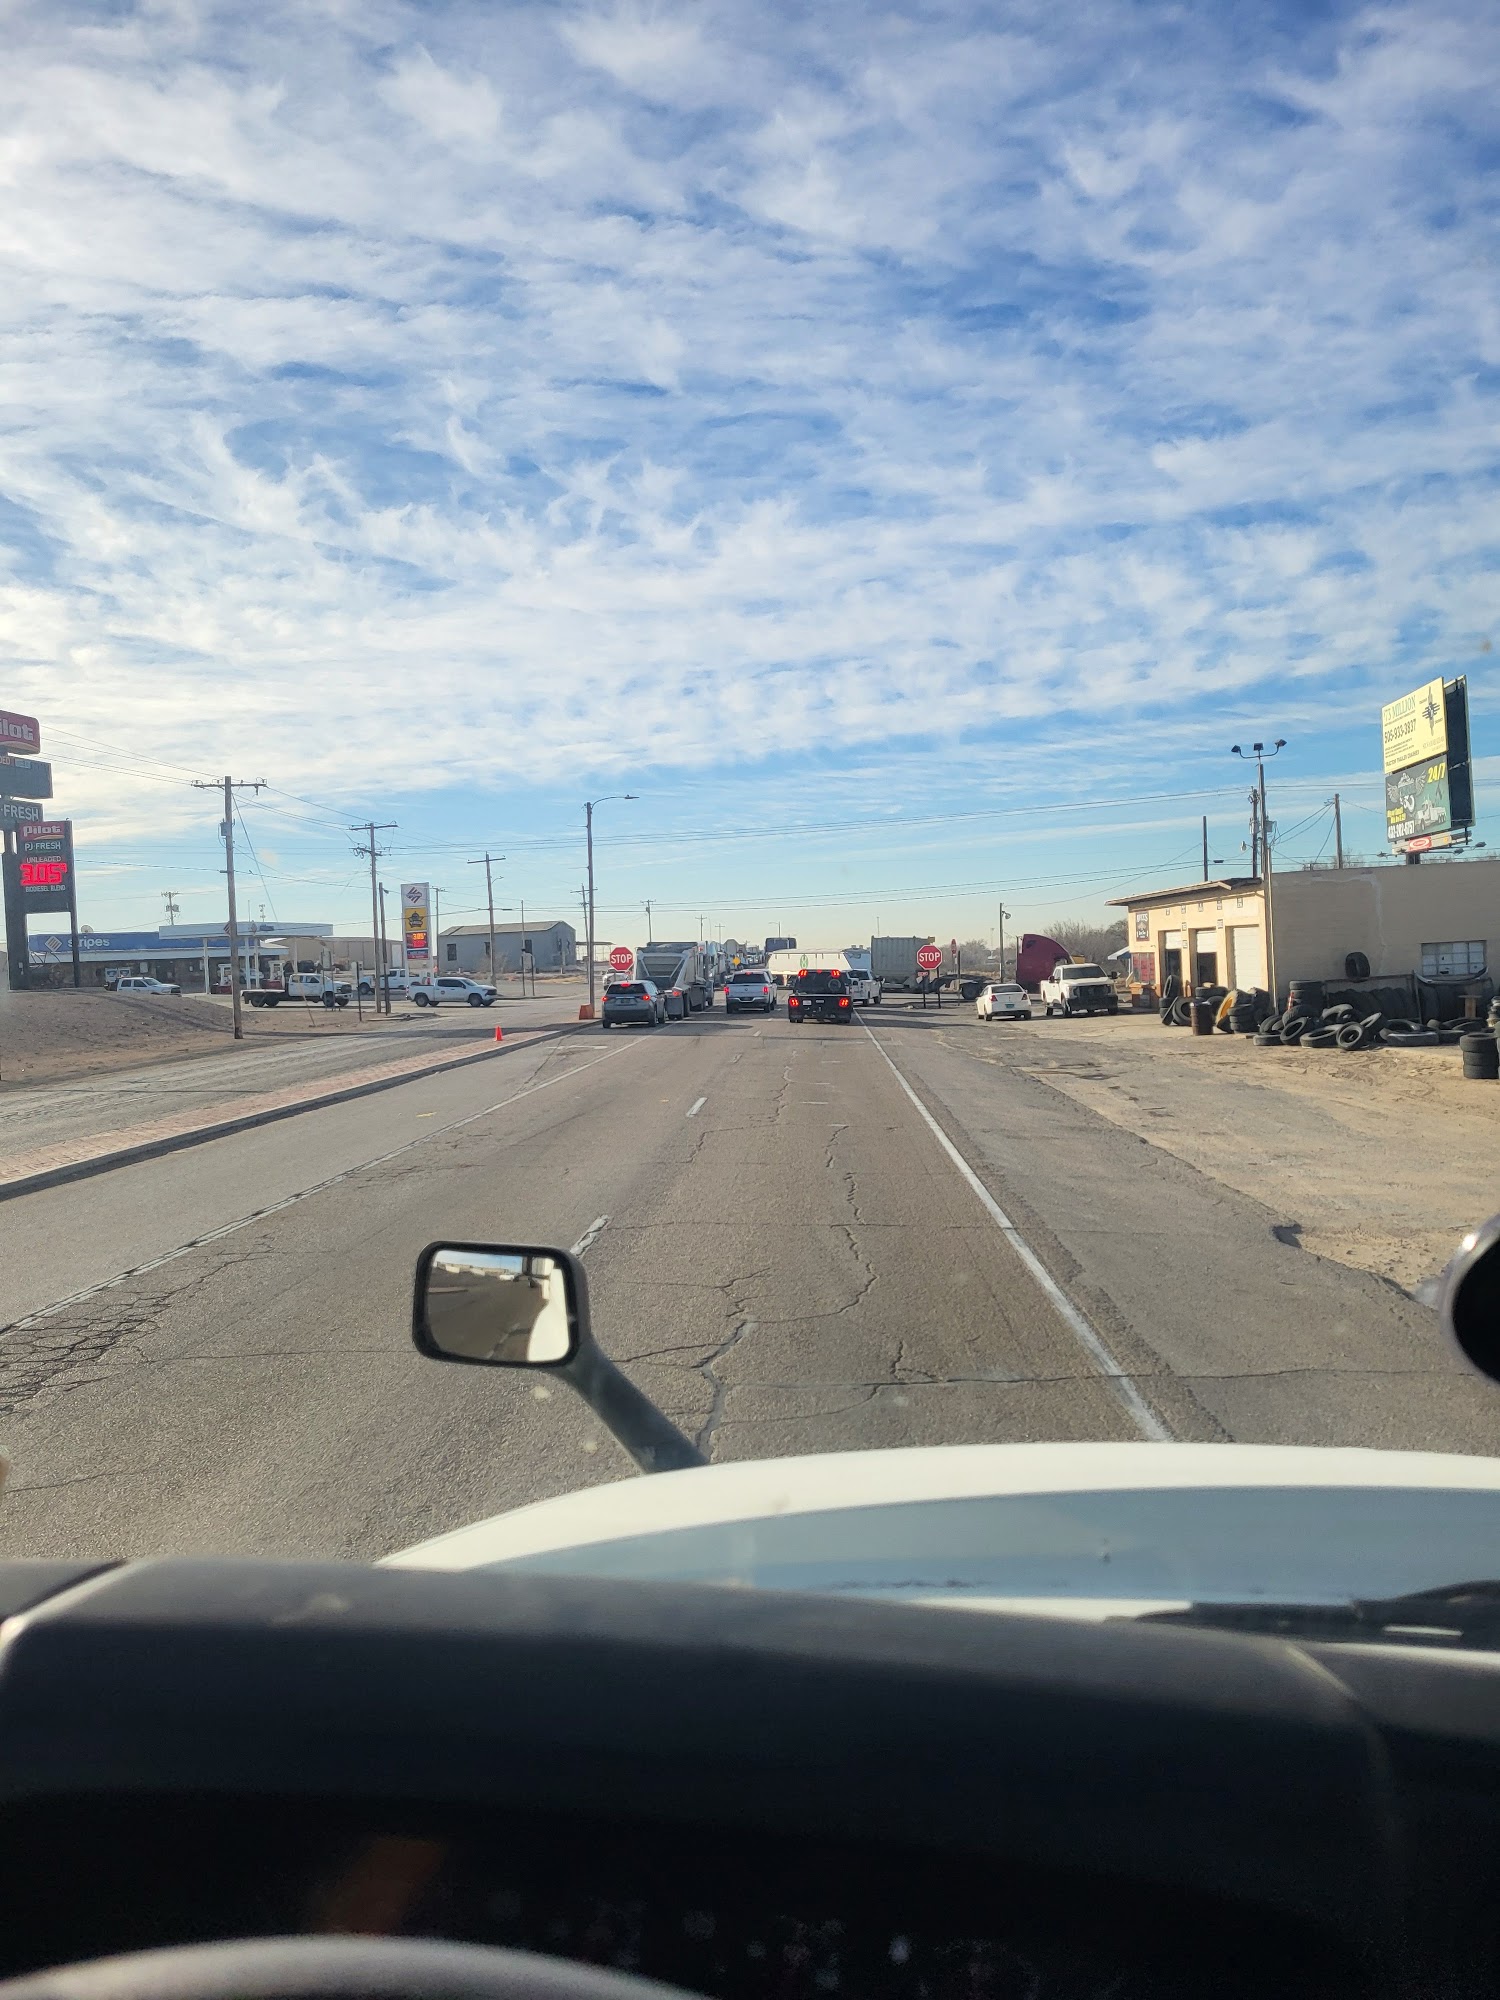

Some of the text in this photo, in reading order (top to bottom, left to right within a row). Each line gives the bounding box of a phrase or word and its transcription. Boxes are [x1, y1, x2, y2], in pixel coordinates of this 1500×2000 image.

[0, 719, 34, 740] ilot
[1427, 762, 1446, 783] 24/7
[67, 936, 110, 949] sripes
[611, 954, 633, 964] STOP
[919, 952, 941, 962] STOP
